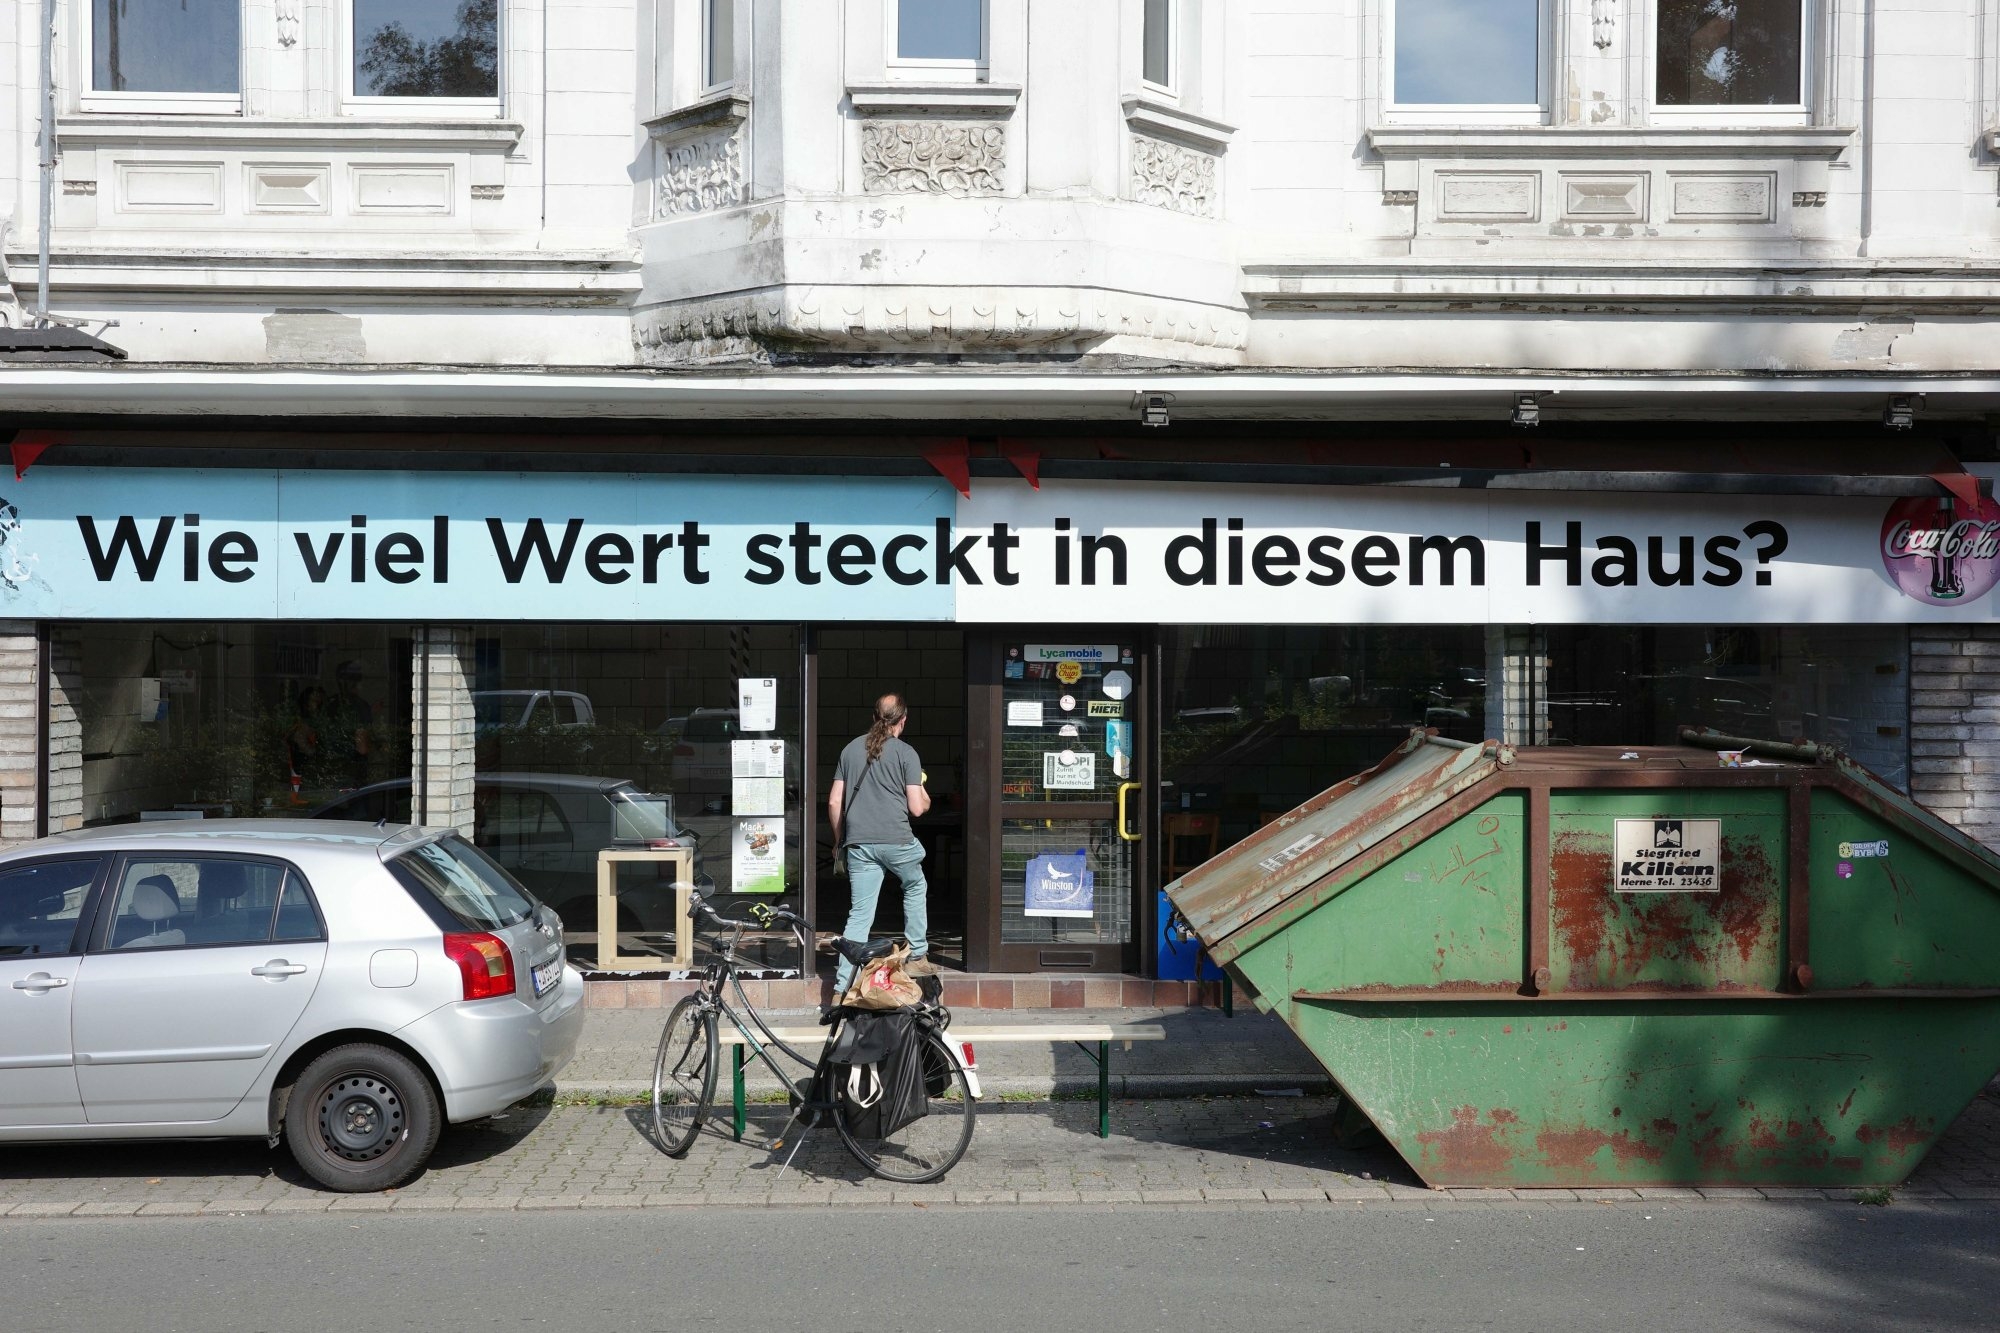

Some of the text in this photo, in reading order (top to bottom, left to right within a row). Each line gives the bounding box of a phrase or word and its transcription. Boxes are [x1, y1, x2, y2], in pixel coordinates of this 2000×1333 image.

[1884, 519, 2000, 559] Coca-Cola
[76, 514, 1788, 587] Wie viel Wert steckt in diesem Haus?
[1039, 648, 1103, 659] Lycamobile
[1060, 663, 1079, 671] Chupa
[1058, 669, 1079, 679] Chups
[1090, 705, 1122, 714] HIER!
[1635, 849, 1701, 860] Siegfried
[1620, 861, 1715, 876] Kilian
[1041, 879, 1074, 891] Winston
[1620, 877, 1713, 886] Herne Tel. 23436
